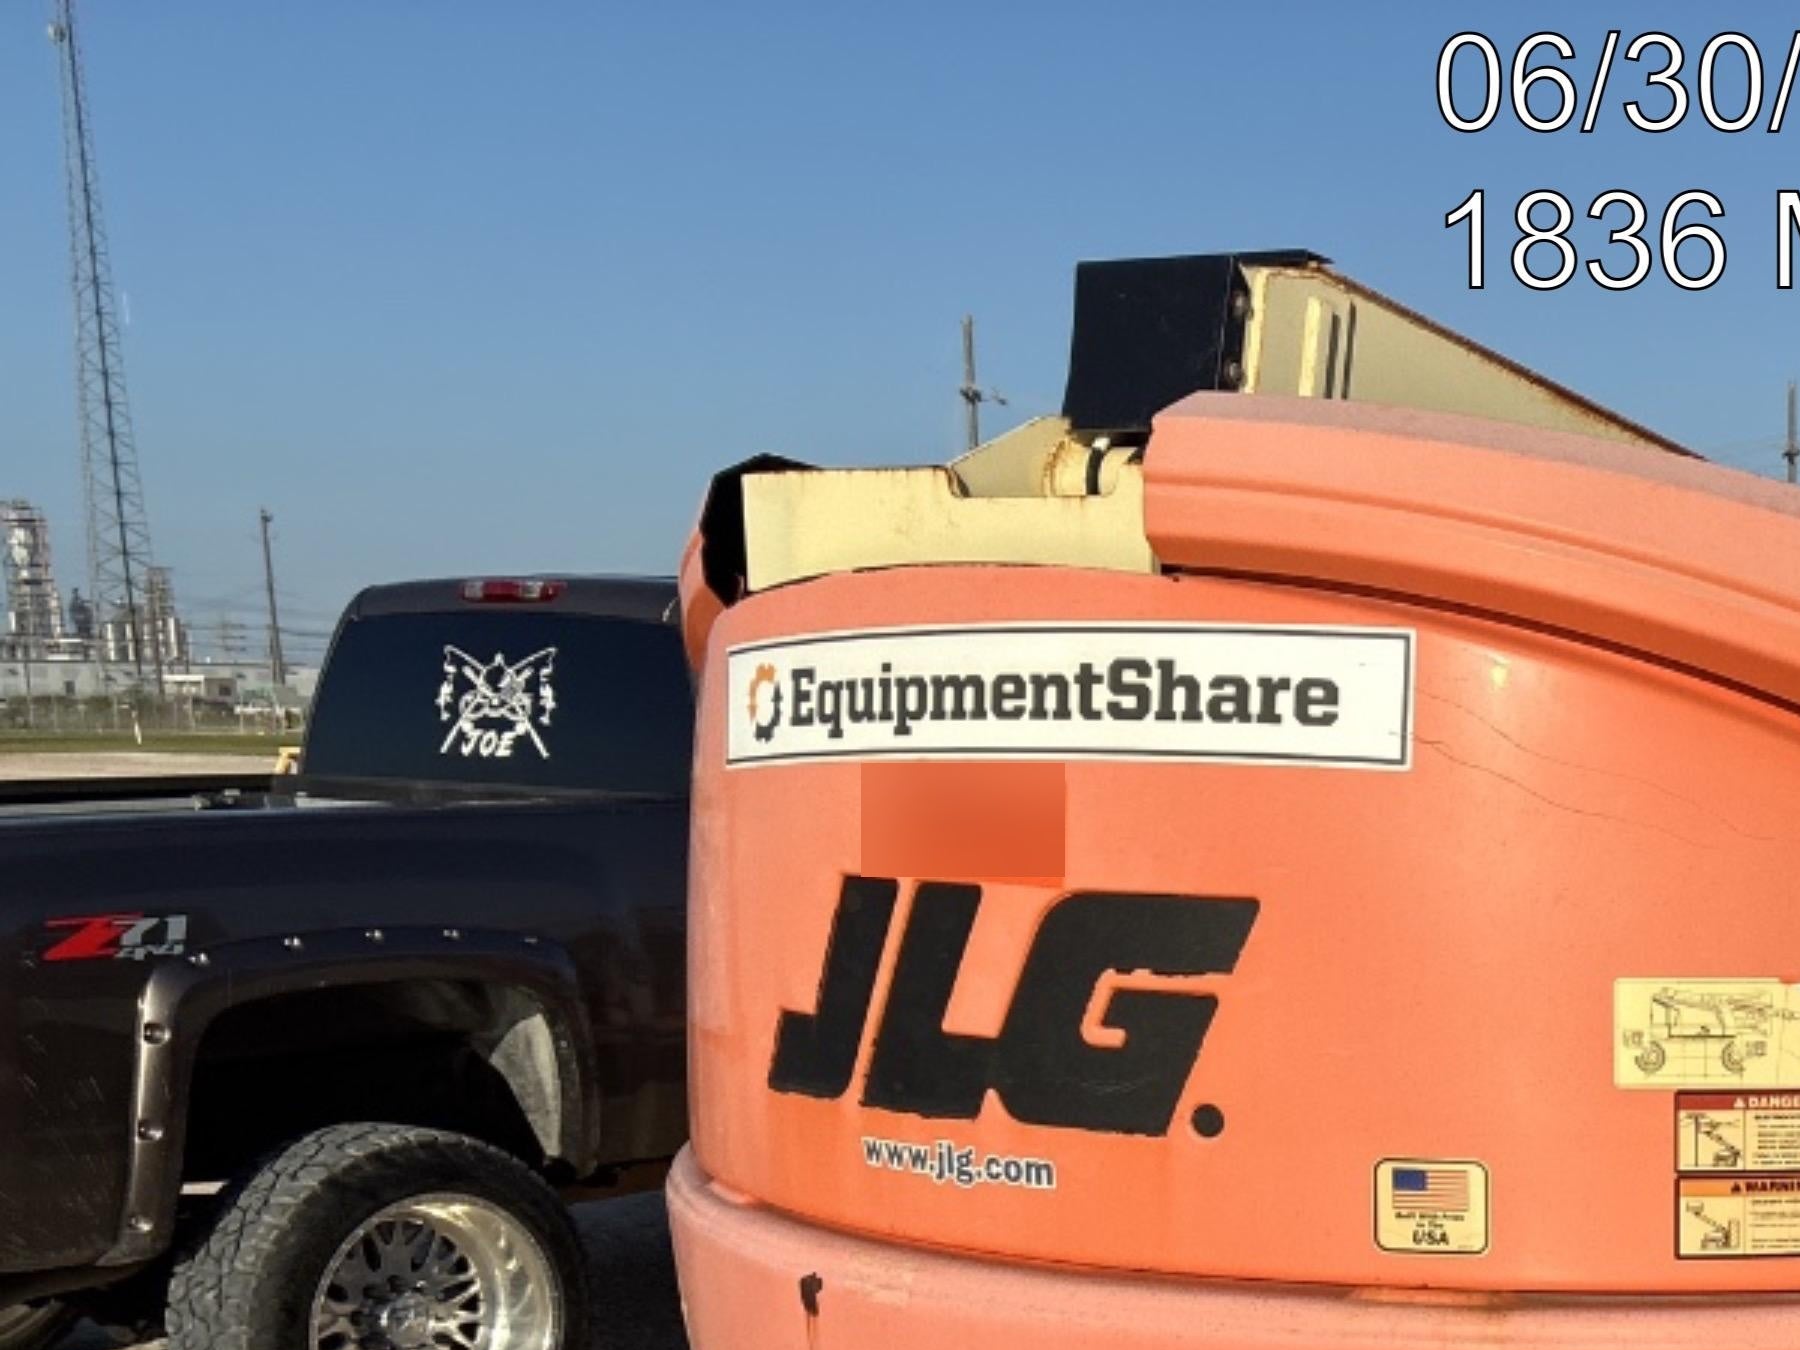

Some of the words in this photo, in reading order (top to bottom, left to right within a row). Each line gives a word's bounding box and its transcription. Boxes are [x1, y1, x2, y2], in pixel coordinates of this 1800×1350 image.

[789, 658, 1341, 739] EquipmentShare
[461, 729, 516, 757] JOE
[43, 911, 188, 960] Z71
[861, 1137, 1056, 1189] www.jlg.com
